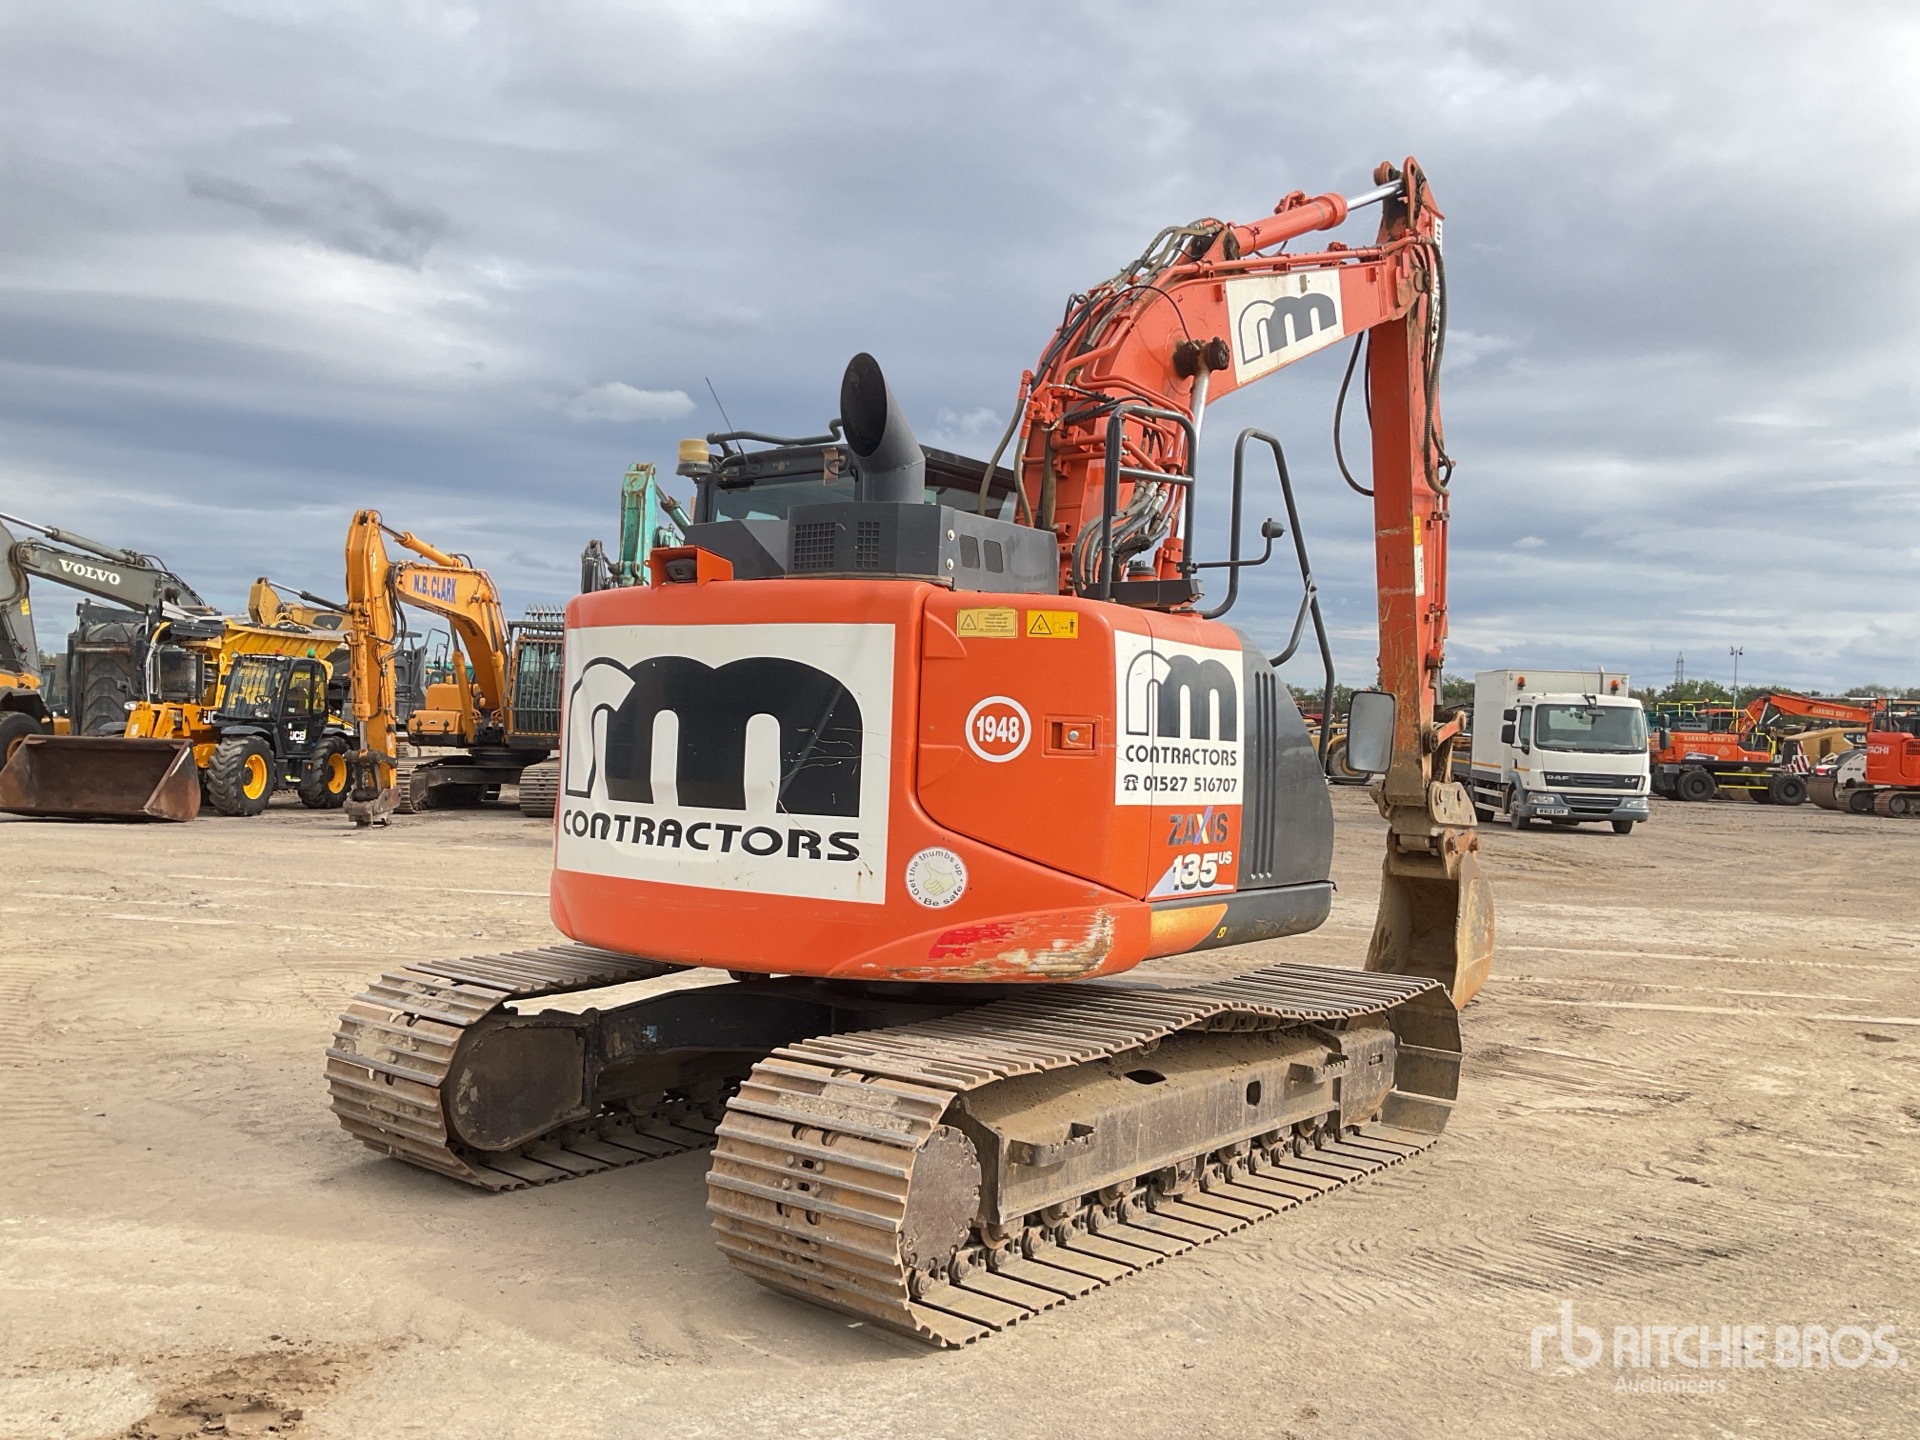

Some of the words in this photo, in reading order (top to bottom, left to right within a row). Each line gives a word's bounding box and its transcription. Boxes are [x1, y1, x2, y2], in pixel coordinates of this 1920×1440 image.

[58, 558, 120, 585] VOLVO
[414, 574, 430, 595] N.B.
[431, 575, 457, 604] CLARK
[203, 711, 218, 724] JC
[290, 730, 306, 741] JCB
[976, 715, 1020, 744] 1948
[1125, 745, 1237, 766] CONTRACTORS
[1143, 775, 1188, 792] 01527
[1193, 776, 1237, 792] 516707
[1168, 805, 1228, 846] ZAXIS
[563, 809, 860, 862] CONTRACTORS
[918, 850, 955, 863] thumbs
[909, 861, 919, 876] the
[954, 863, 963, 876] up
[909, 879, 920, 896] Get
[923, 897, 940, 907] Be
[943, 885, 963, 905] safe
